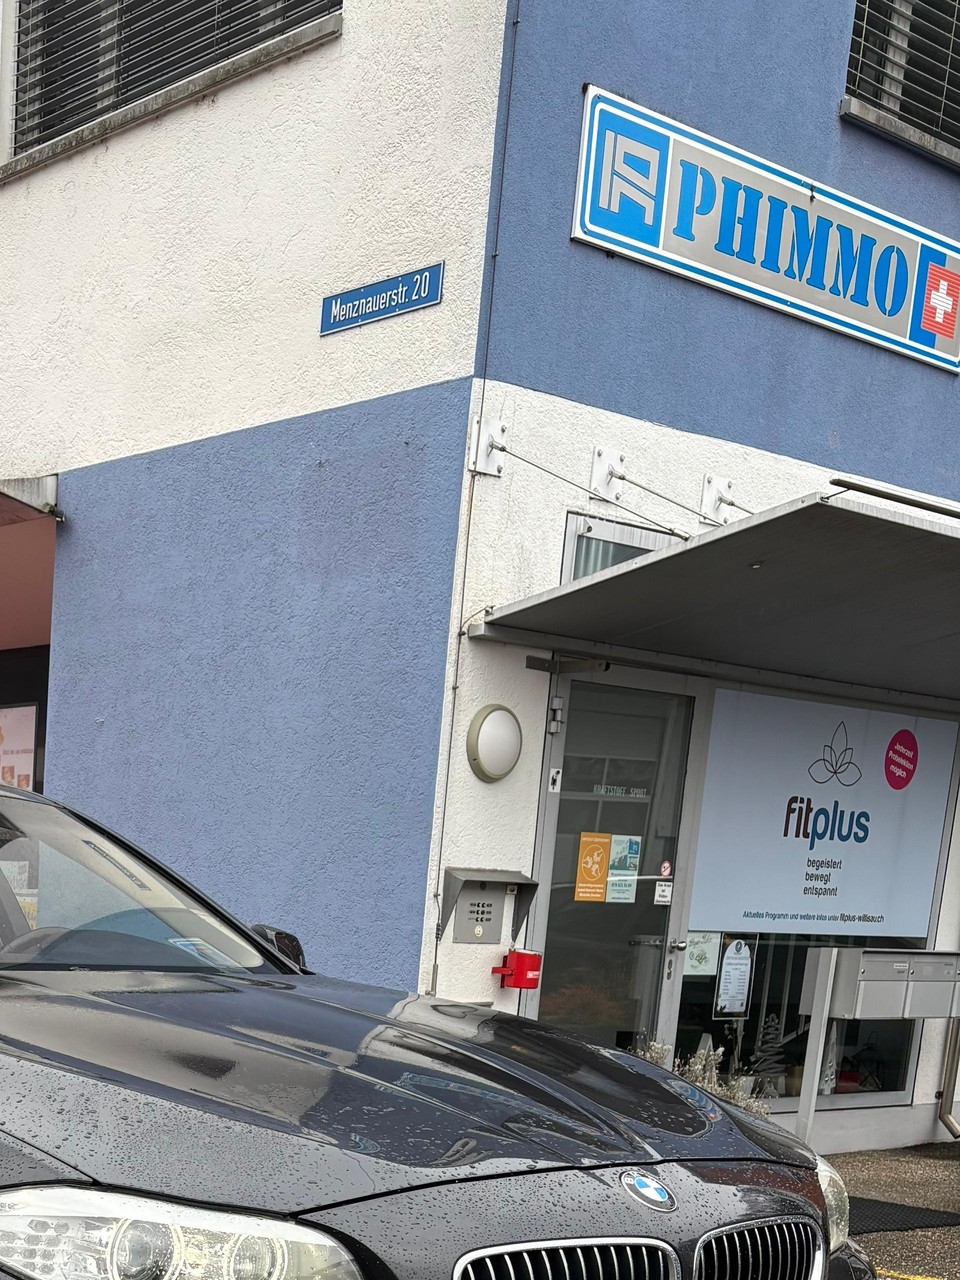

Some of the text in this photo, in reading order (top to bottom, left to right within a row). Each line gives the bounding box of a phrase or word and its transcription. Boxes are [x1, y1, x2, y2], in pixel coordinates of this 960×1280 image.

[672, 159, 909, 317] PHIMMO
[331, 272, 429, 323] Menznauerstr. 20
[783, 796, 870, 850] fitplus
[805, 871, 831, 885] bewegt
[807, 857, 842, 871] begeistert
[803, 886, 838, 898] entspannt
